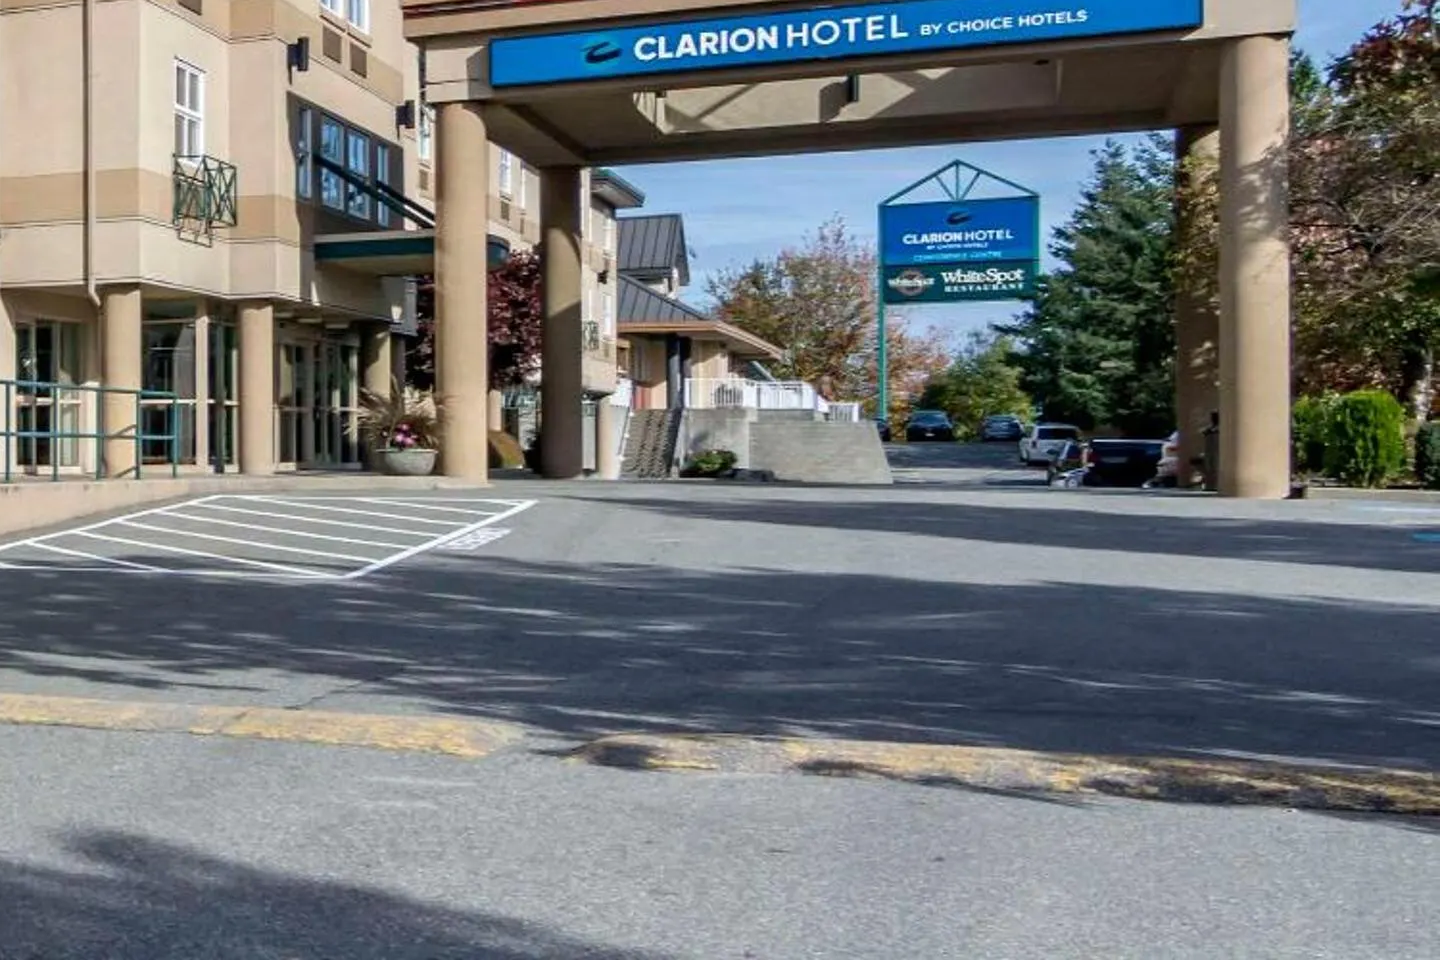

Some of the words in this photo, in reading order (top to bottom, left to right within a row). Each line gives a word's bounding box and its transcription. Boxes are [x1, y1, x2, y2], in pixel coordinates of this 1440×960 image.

[633, 25, 779, 61] CLARION
[786, 14, 909, 48] HOTEL
[920, 23, 941, 36] BY
[947, 17, 1013, 35] CHOICE
[1018, 9, 1088, 28] HOTELS
[902, 231, 963, 245] CLARION
[964, 229, 1014, 242] HOTEL
